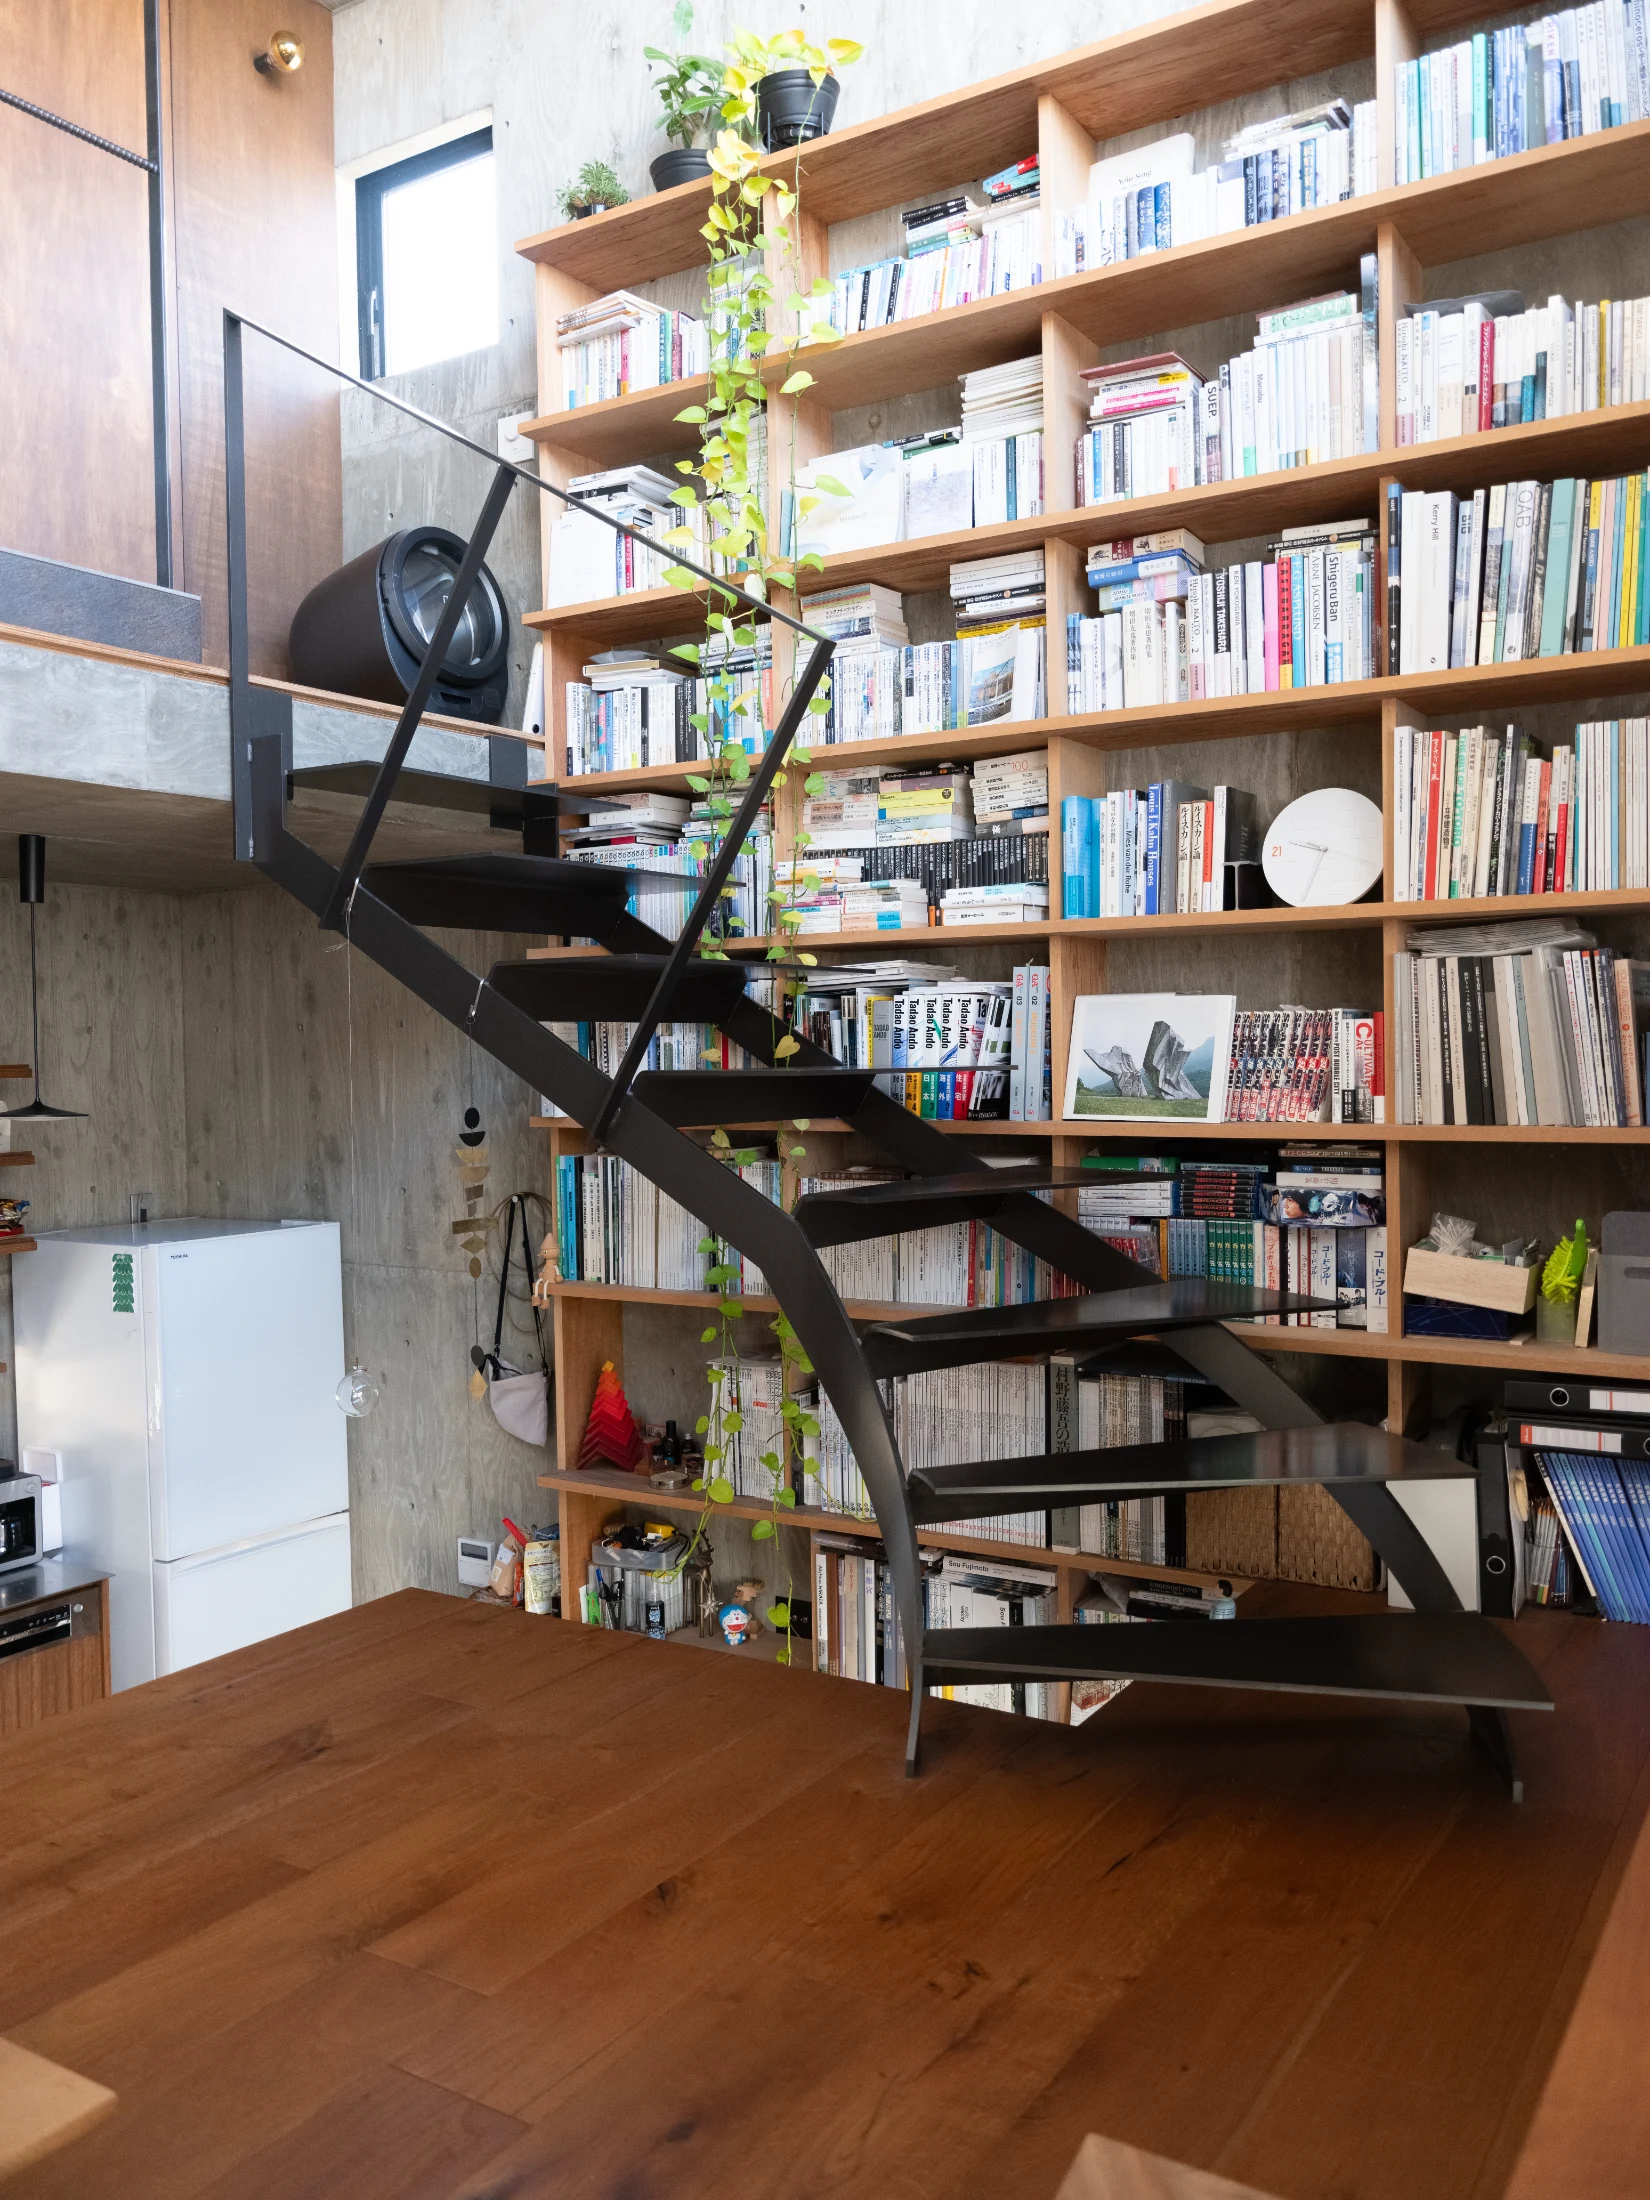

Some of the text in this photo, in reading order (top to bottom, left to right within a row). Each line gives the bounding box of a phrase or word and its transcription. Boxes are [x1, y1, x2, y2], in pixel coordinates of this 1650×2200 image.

[1625, 40, 1639, 112] SMALL HOUSES
[1136, 169, 1152, 180] Song
[1401, 322, 1409, 351] Hiroshi
[1401, 354, 1409, 384] NAITO
[1207, 386, 1218, 418] SUEP.
[1461, 514, 1471, 535] BIG
[1281, 560, 1289, 593] CASA
[1329, 557, 1339, 622] Shigeru Ban
[1345, 559, 1354, 591] WARO
[1312, 555, 1320, 630] ARNE JACOBSEN
[1216, 611, 1227, 653] TAKEHARA
[1011, 760, 1029, 773] 100
[1148, 786, 1159, 817] Louis
[1453, 734, 1467, 848] THE ART OF TOTORO
[1271, 845, 1283, 858] 21
[1147, 851, 1157, 887] Houses
[1015, 974, 1024, 1006] GA 03
[1031, 974, 1038, 1006] GA 02
[1619, 968, 1628, 984] YOU
[1621, 984, 1629, 999] ARE
[894, 999, 905, 1049] Tadao Ando
[908, 999, 920, 1050] Tadao Ando
[925, 998, 937, 1049] Tadao Ando
[942, 998, 953, 1049] Tadao Ando
[959, 998, 972, 1049] Tadao Ando
[912, 1103, 917, 1112] 4
[930, 1102, 935, 1111] 3
[945, 1102, 950, 1111] 2
[961, 1103, 966, 1111] 1
[1373, 1250, 1386, 1306] コード・ブルー
[948, 1560, 989, 1573] Sou Fujimoto
[1149, 1581, 1181, 1591] SHIGENORI
